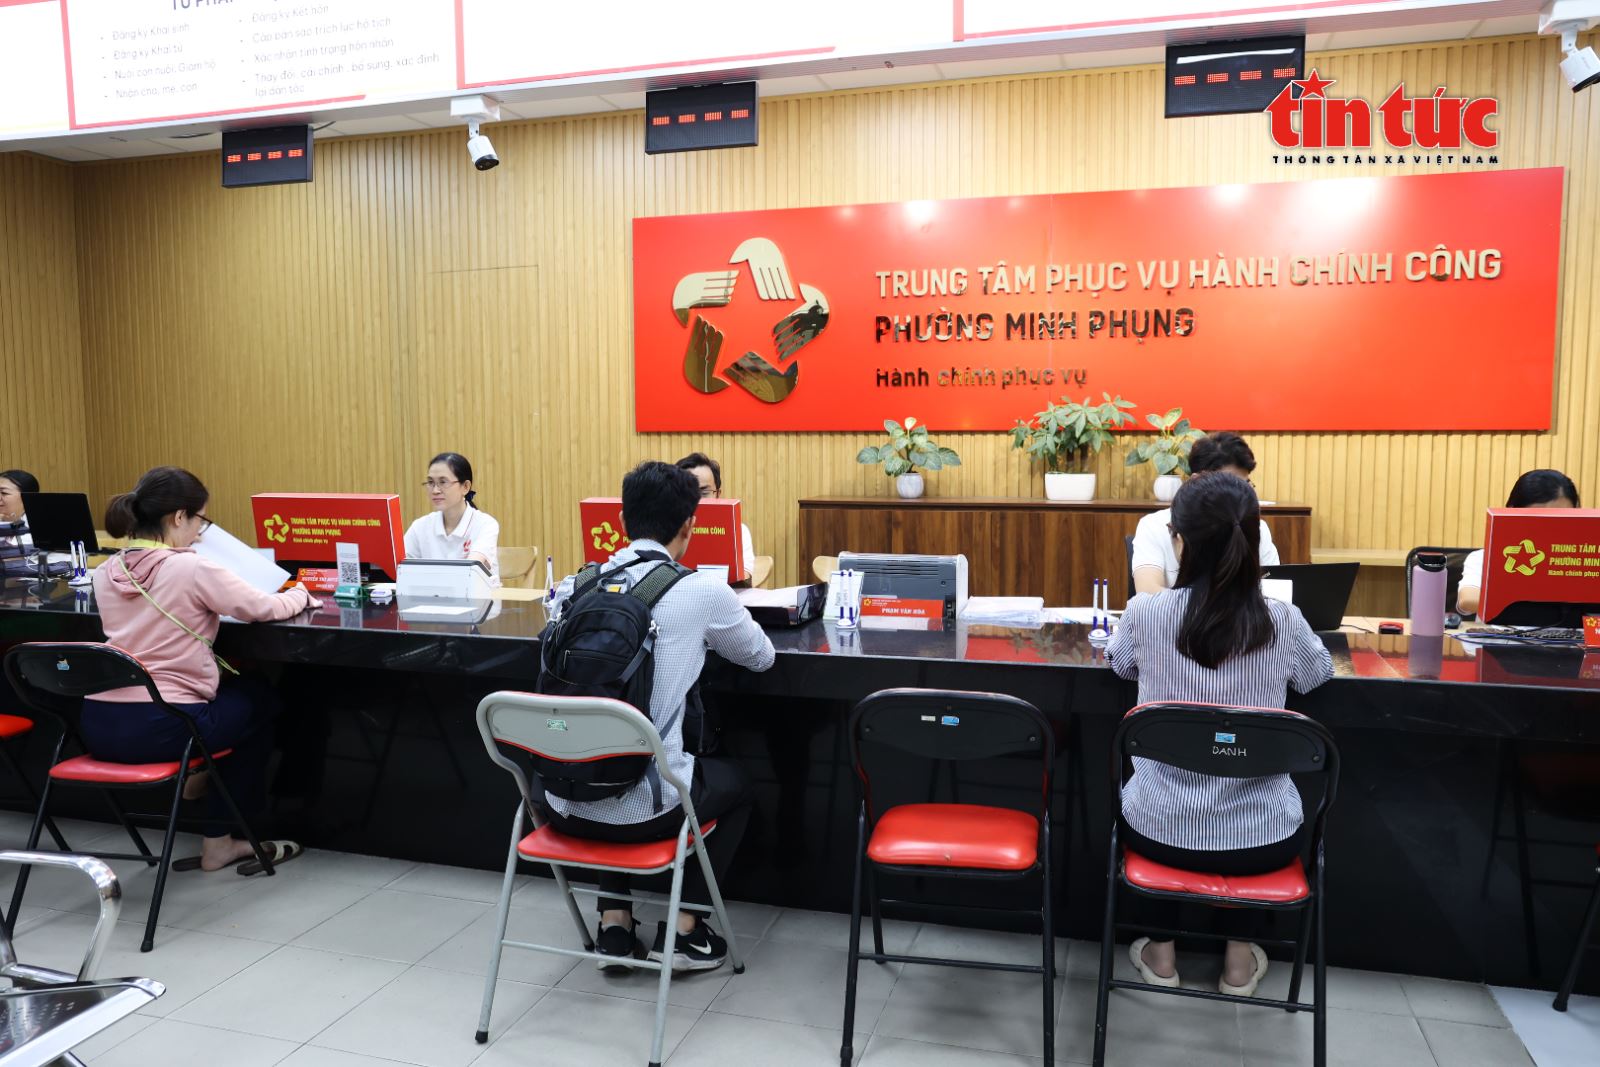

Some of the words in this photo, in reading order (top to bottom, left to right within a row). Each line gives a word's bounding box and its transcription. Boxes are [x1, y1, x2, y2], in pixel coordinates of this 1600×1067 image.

[875, 266, 968, 298] TRUNG
[976, 259, 1034, 295] TÂM
[1045, 261, 1127, 299] PHỤC
[1136, 259, 1180, 296] VỤ
[1189, 252, 1279, 288] HÀNH
[1289, 247, 1393, 286] CHÍNH
[1404, 243, 1502, 281] CÔNG
[875, 306, 994, 343] PHƯỜNG
[1005, 310, 1077, 340] MINH
[1088, 307, 1194, 344] PHỤNG
[876, 367, 929, 387] Hành
[937, 366, 996, 386] chính
[1001, 366, 1055, 391] phục
[1060, 367, 1088, 389] vụ
[1551, 544, 1577, 553] TRUNG
[1579, 543, 1596, 553] TÂM
[1549, 555, 1582, 566] PHƯỜNG
[1583, 558, 1600, 567] MIN
[1212, 745, 1247, 757] DANH
